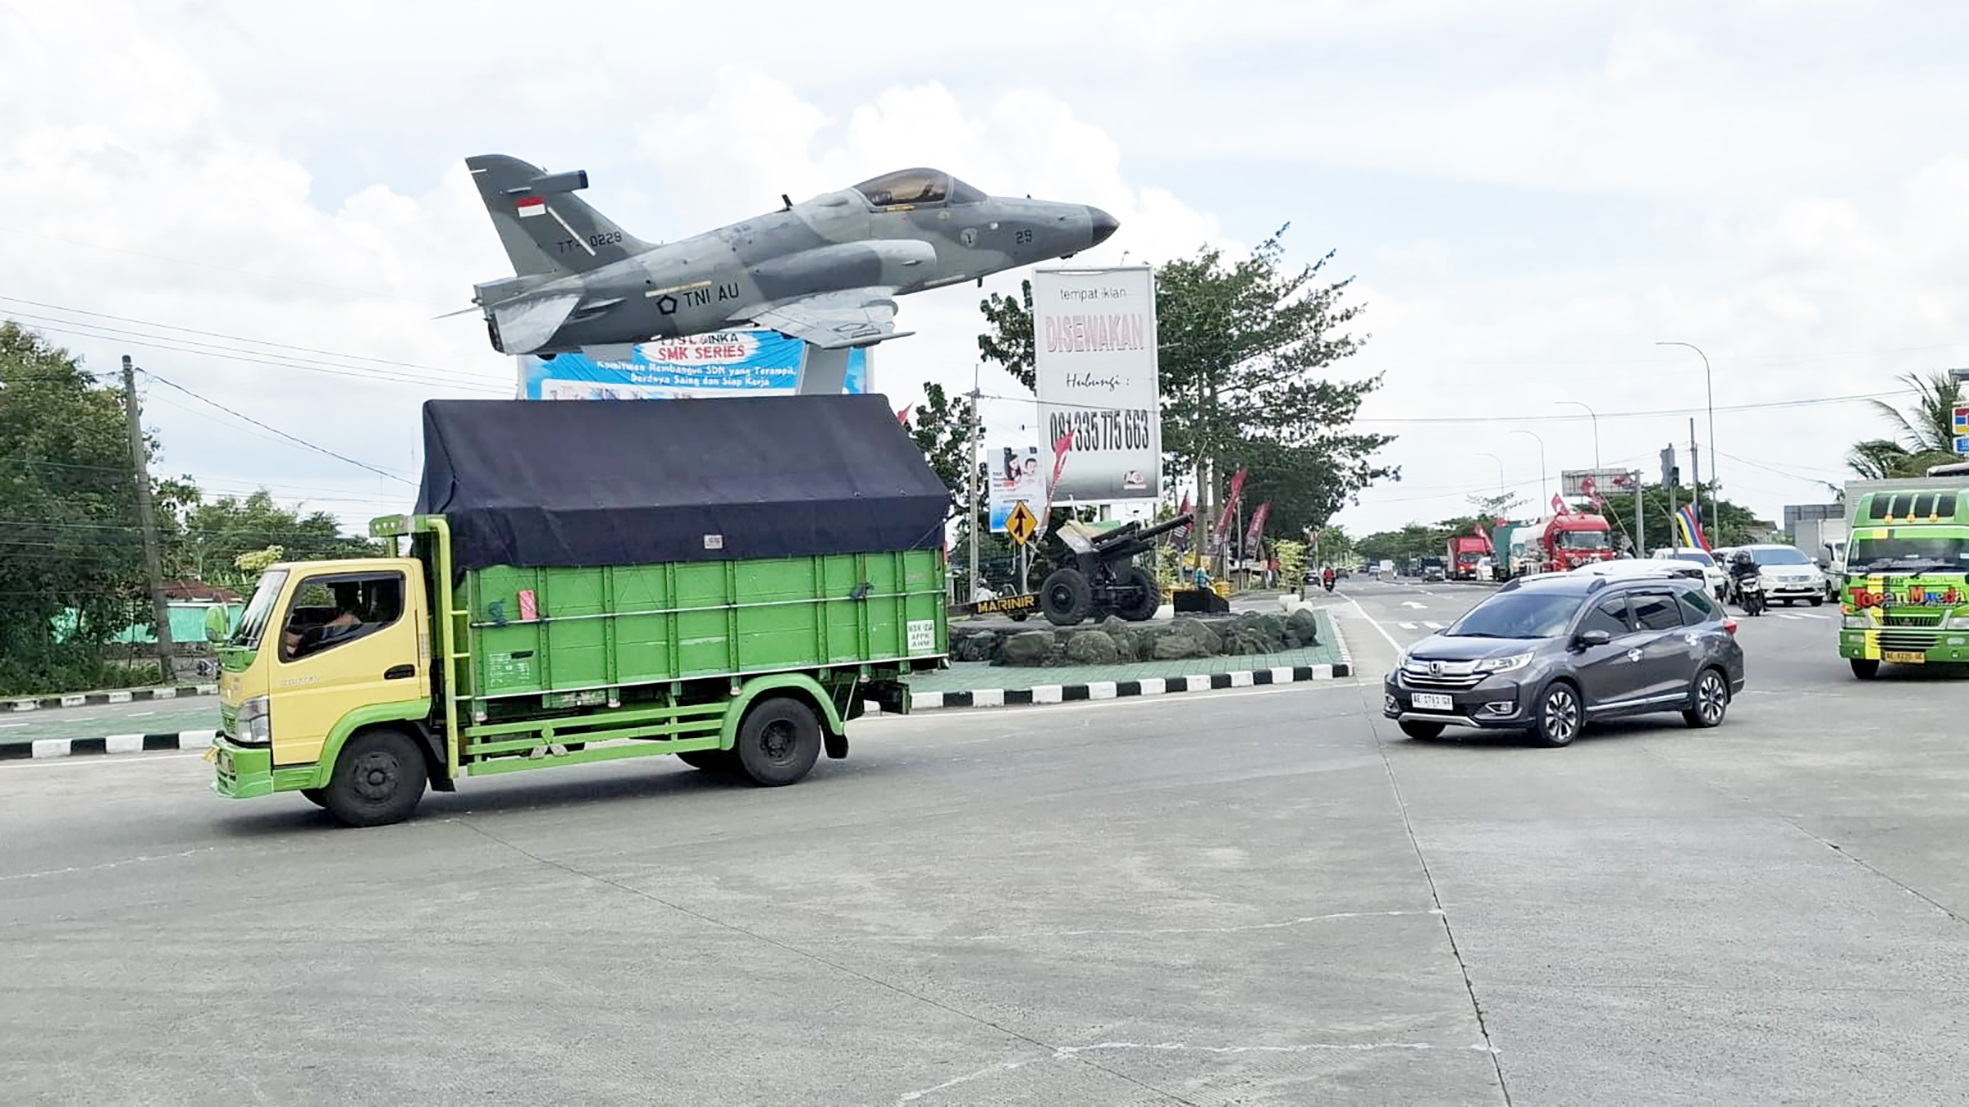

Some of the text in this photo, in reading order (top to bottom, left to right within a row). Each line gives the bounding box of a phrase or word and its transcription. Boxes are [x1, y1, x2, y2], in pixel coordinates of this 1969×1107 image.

[1015, 229, 1032, 244] 29
[683, 283, 740, 307] TNI AU
[1060, 288, 1098, 302] tempat
[1045, 314, 1144, 352] DISEWAKAN
[658, 344, 745, 361] SMK SERIES
[729, 367, 751, 377] yang
[703, 376, 719, 385] dan
[745, 376, 769, 387] Kerja
[1074, 411, 1099, 452] 335
[1101, 410, 1122, 450] 775
[1125, 409, 1149, 450] 663
[977, 595, 1035, 613] MARINIR
